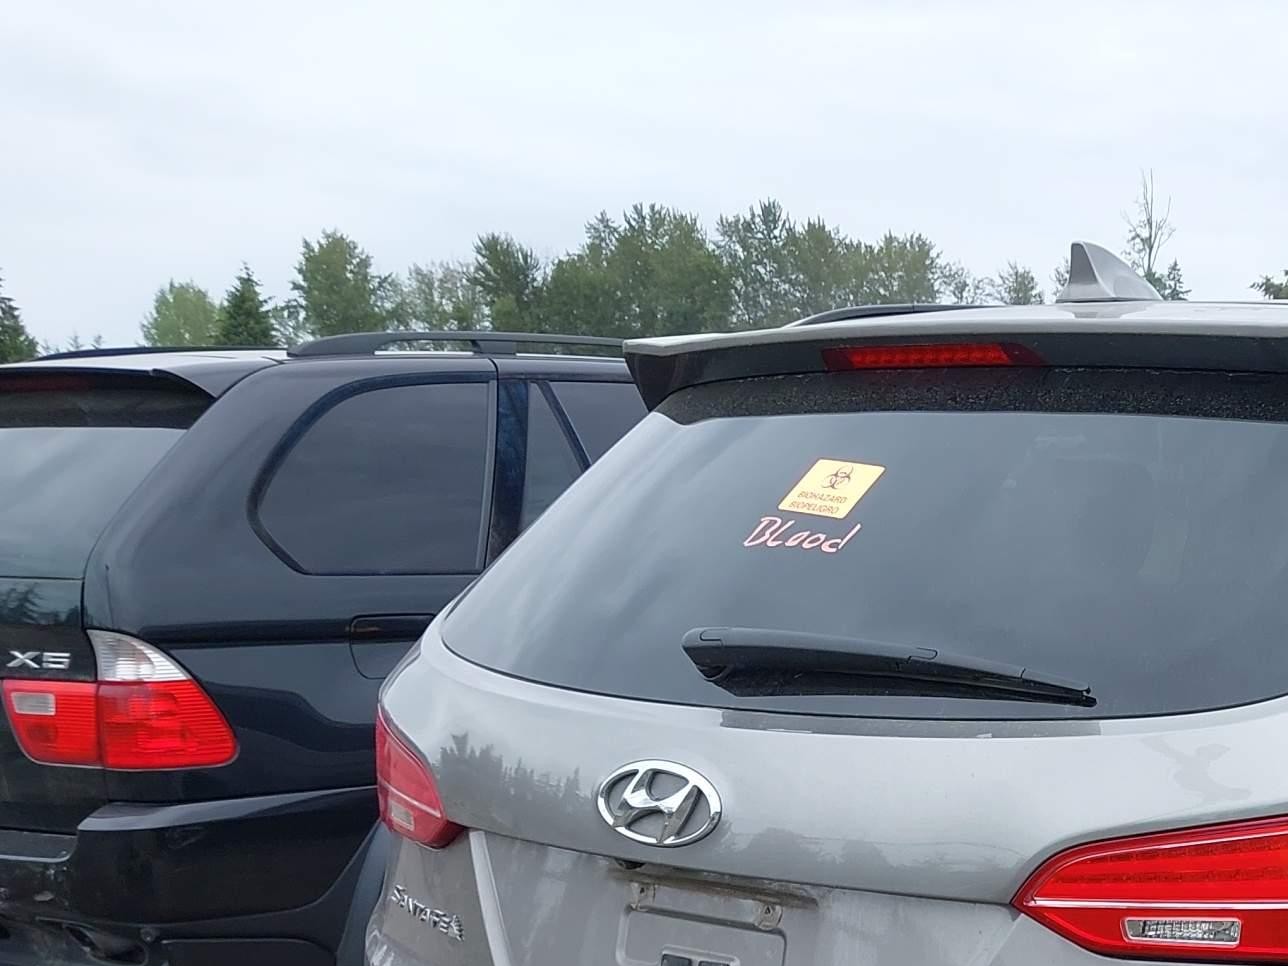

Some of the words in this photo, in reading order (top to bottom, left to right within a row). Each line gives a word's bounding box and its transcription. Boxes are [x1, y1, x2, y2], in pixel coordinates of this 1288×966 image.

[797, 491, 848, 504] BIOHAZARD
[789, 501, 839, 513] BIOPELIGRO
[6, 651, 71, 669] X5
